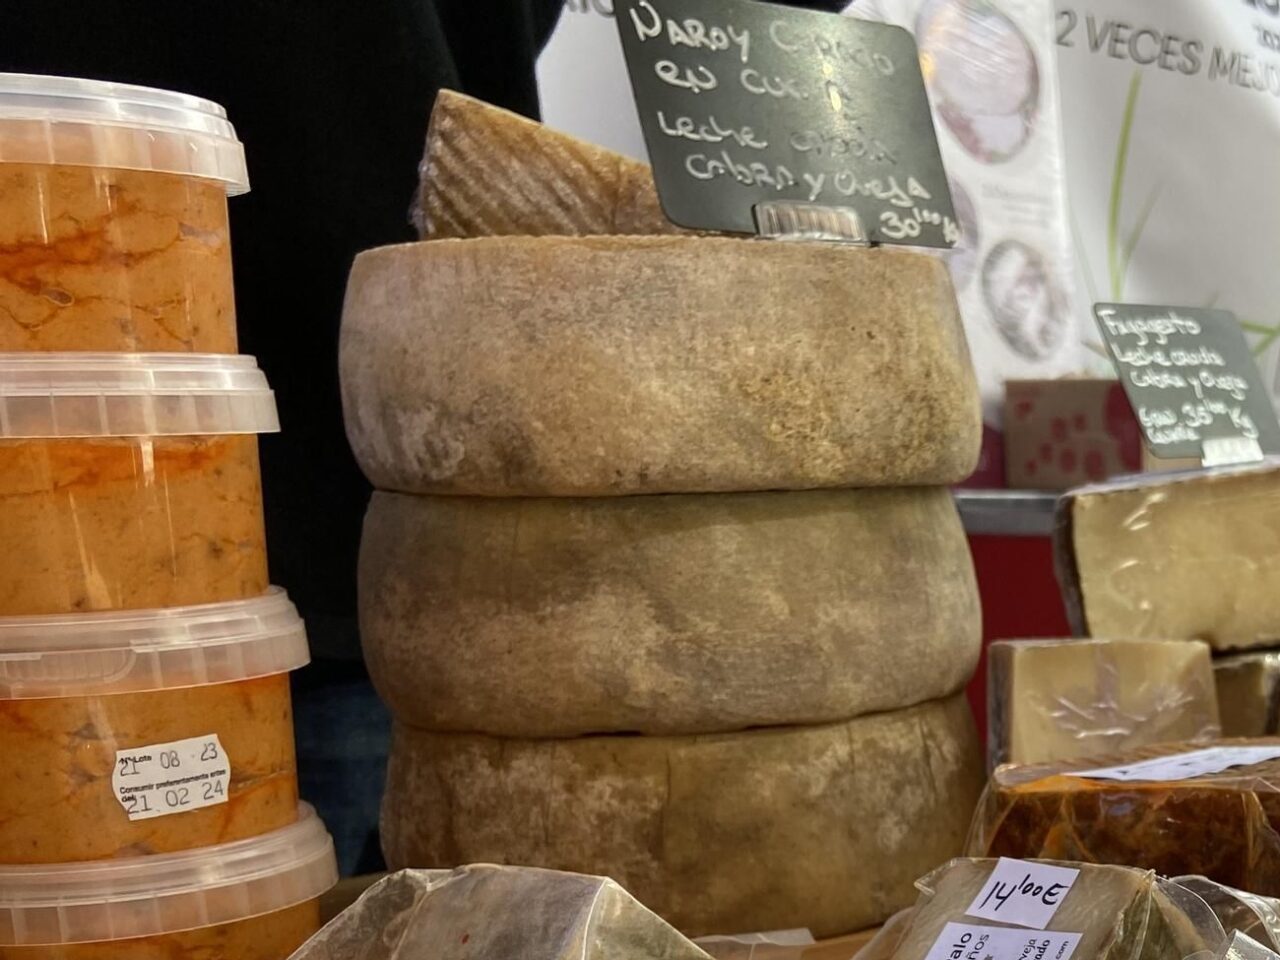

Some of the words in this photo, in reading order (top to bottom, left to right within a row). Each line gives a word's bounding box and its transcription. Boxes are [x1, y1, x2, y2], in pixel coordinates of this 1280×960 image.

[1055, 10, 1078, 48] 2
[1085, 14, 1204, 76] VECES
[160, 750, 181, 769] 08
[200, 742, 218, 762] 23
[119, 783, 155, 794] Consumir
[127, 795, 153, 814] 21
[165, 787, 191, 808] 02
[201, 780, 224, 800] 24
